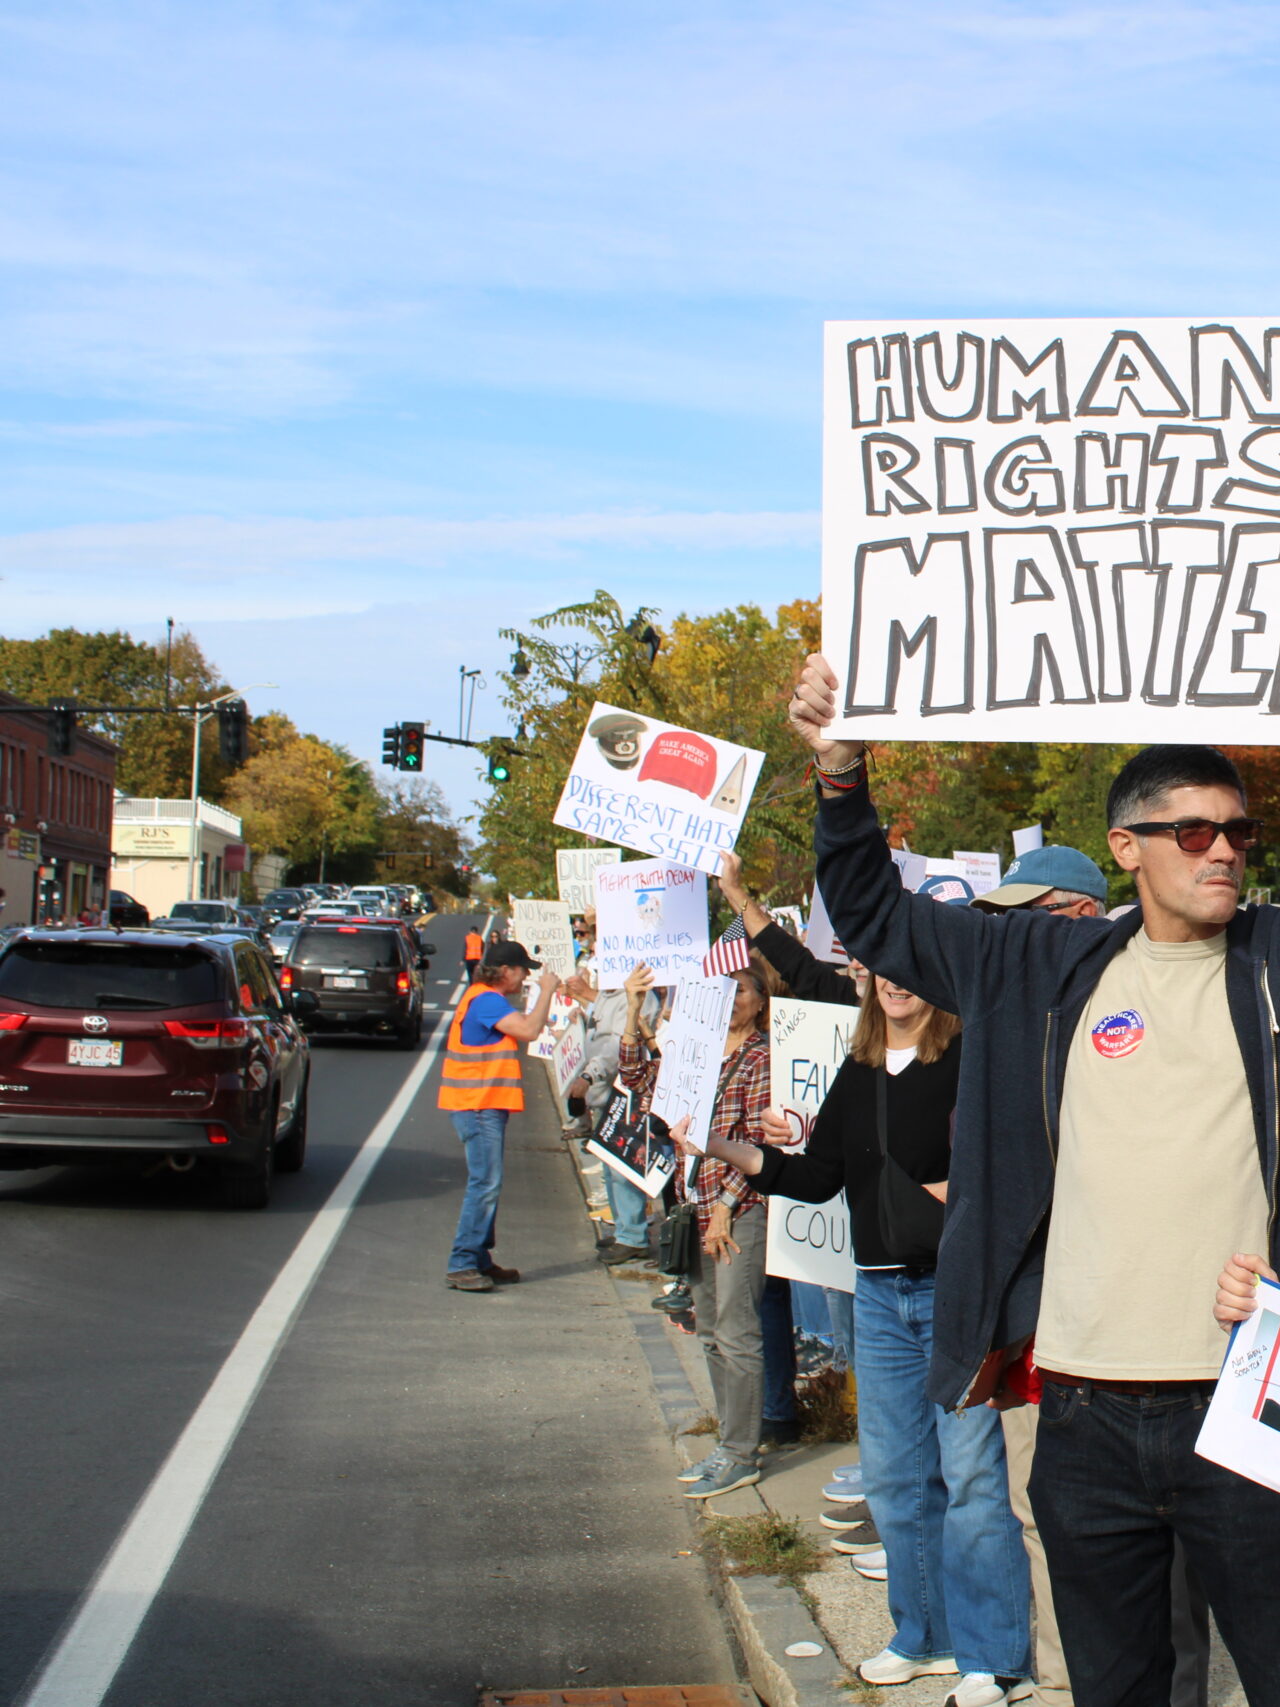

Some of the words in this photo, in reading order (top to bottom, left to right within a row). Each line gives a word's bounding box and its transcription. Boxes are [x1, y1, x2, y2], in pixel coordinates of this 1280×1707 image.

[659, 739, 681, 749] MAKE
[680, 743, 710, 762] AMERICA
[659, 747, 682, 757] GREAT
[682, 752, 705, 767] AGAIN
[566, 775, 683, 831] DIFFERENT
[684, 813, 740, 849] HATS
[141, 827, 169, 838] RJ'S
[565, 807, 638, 846] SAME
[599, 872, 630, 892] FIGHT
[632, 870, 664, 888] TRUTH
[666, 869, 695, 892] DECAY
[518, 903, 534, 920] NO
[603, 935, 619, 951] NO
[625, 933, 660, 951] MORE
[667, 932, 693, 946] LIES
[602, 957, 617, 973] OR
[773, 1008, 787, 1029] NO
[774, 1008, 807, 1047] KINGS
[1097, 1012, 1138, 1034] HEALTHCARE
[1099, 1033, 1134, 1048] WARFARE
[1106, 1026, 1127, 1036] NOT
[561, 1035, 573, 1056] NO
[680, 1034, 709, 1070] KINGS
[560, 1043, 582, 1082] KINGS
[677, 1071, 703, 1095] SINCE
